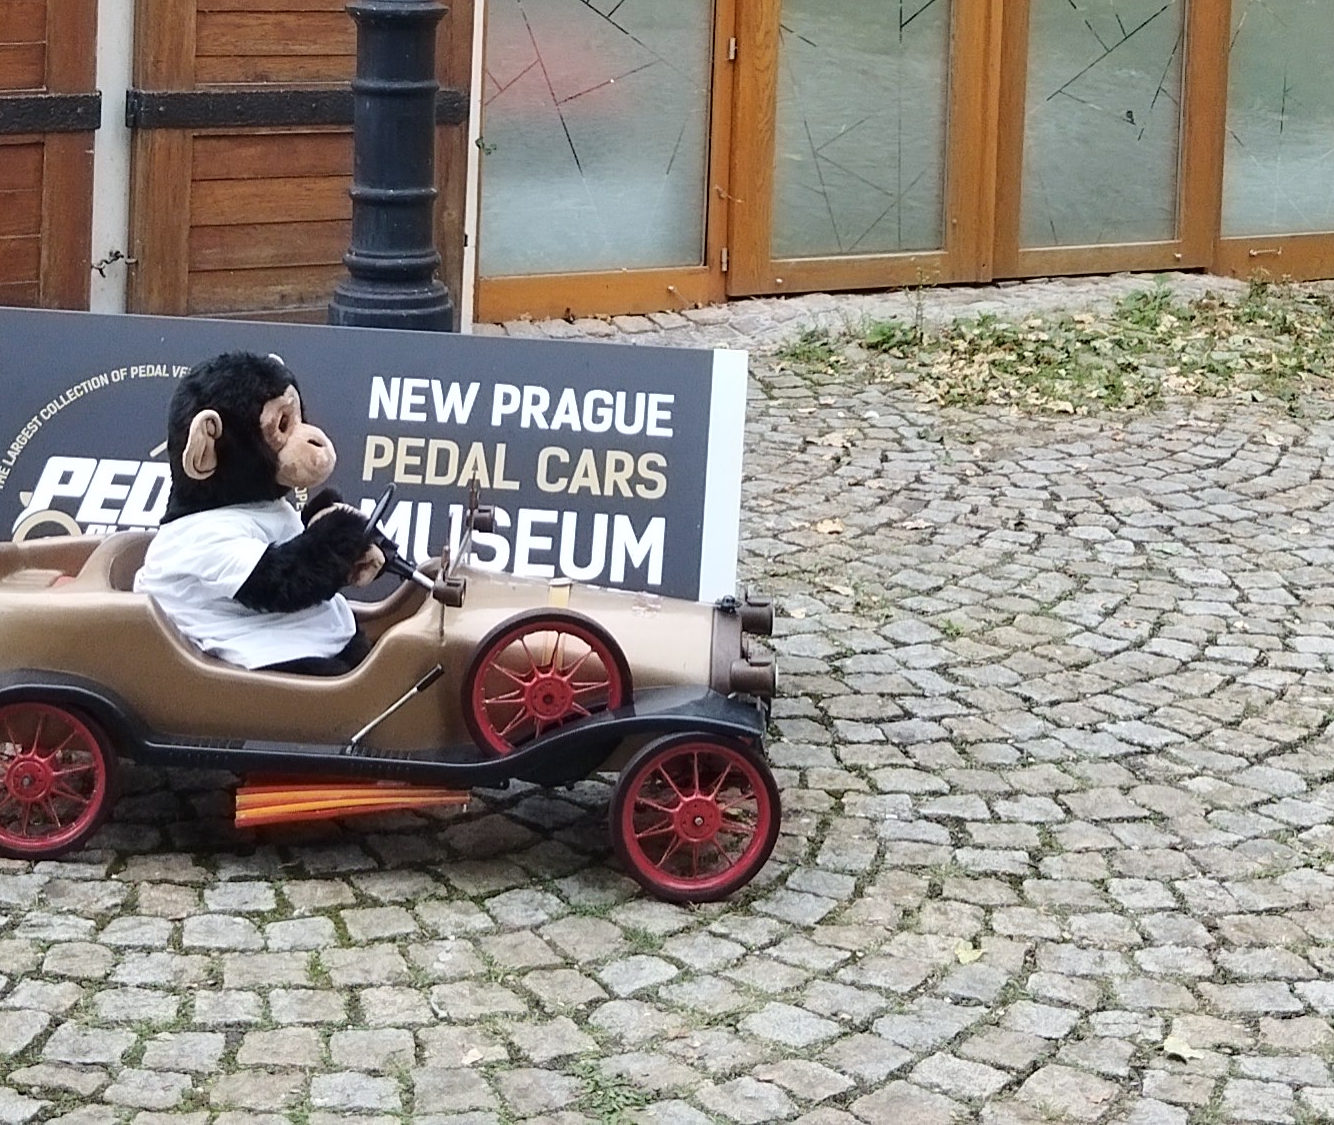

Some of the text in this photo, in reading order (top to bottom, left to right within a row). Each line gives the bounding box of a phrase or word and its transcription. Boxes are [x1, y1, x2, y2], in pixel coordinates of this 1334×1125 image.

[4, 415, 43, 467] LARGEST
[39, 373, 110, 421] COLLECTION
[111, 367, 128, 383] OF
[130, 364, 169, 379] PEDAL
[368, 376, 675, 438] NEW PRAGUE
[12, 456, 173, 531] PED
[362, 435, 668, 500] PEDAL CARS
[359, 498, 666, 586] MUSEUM
